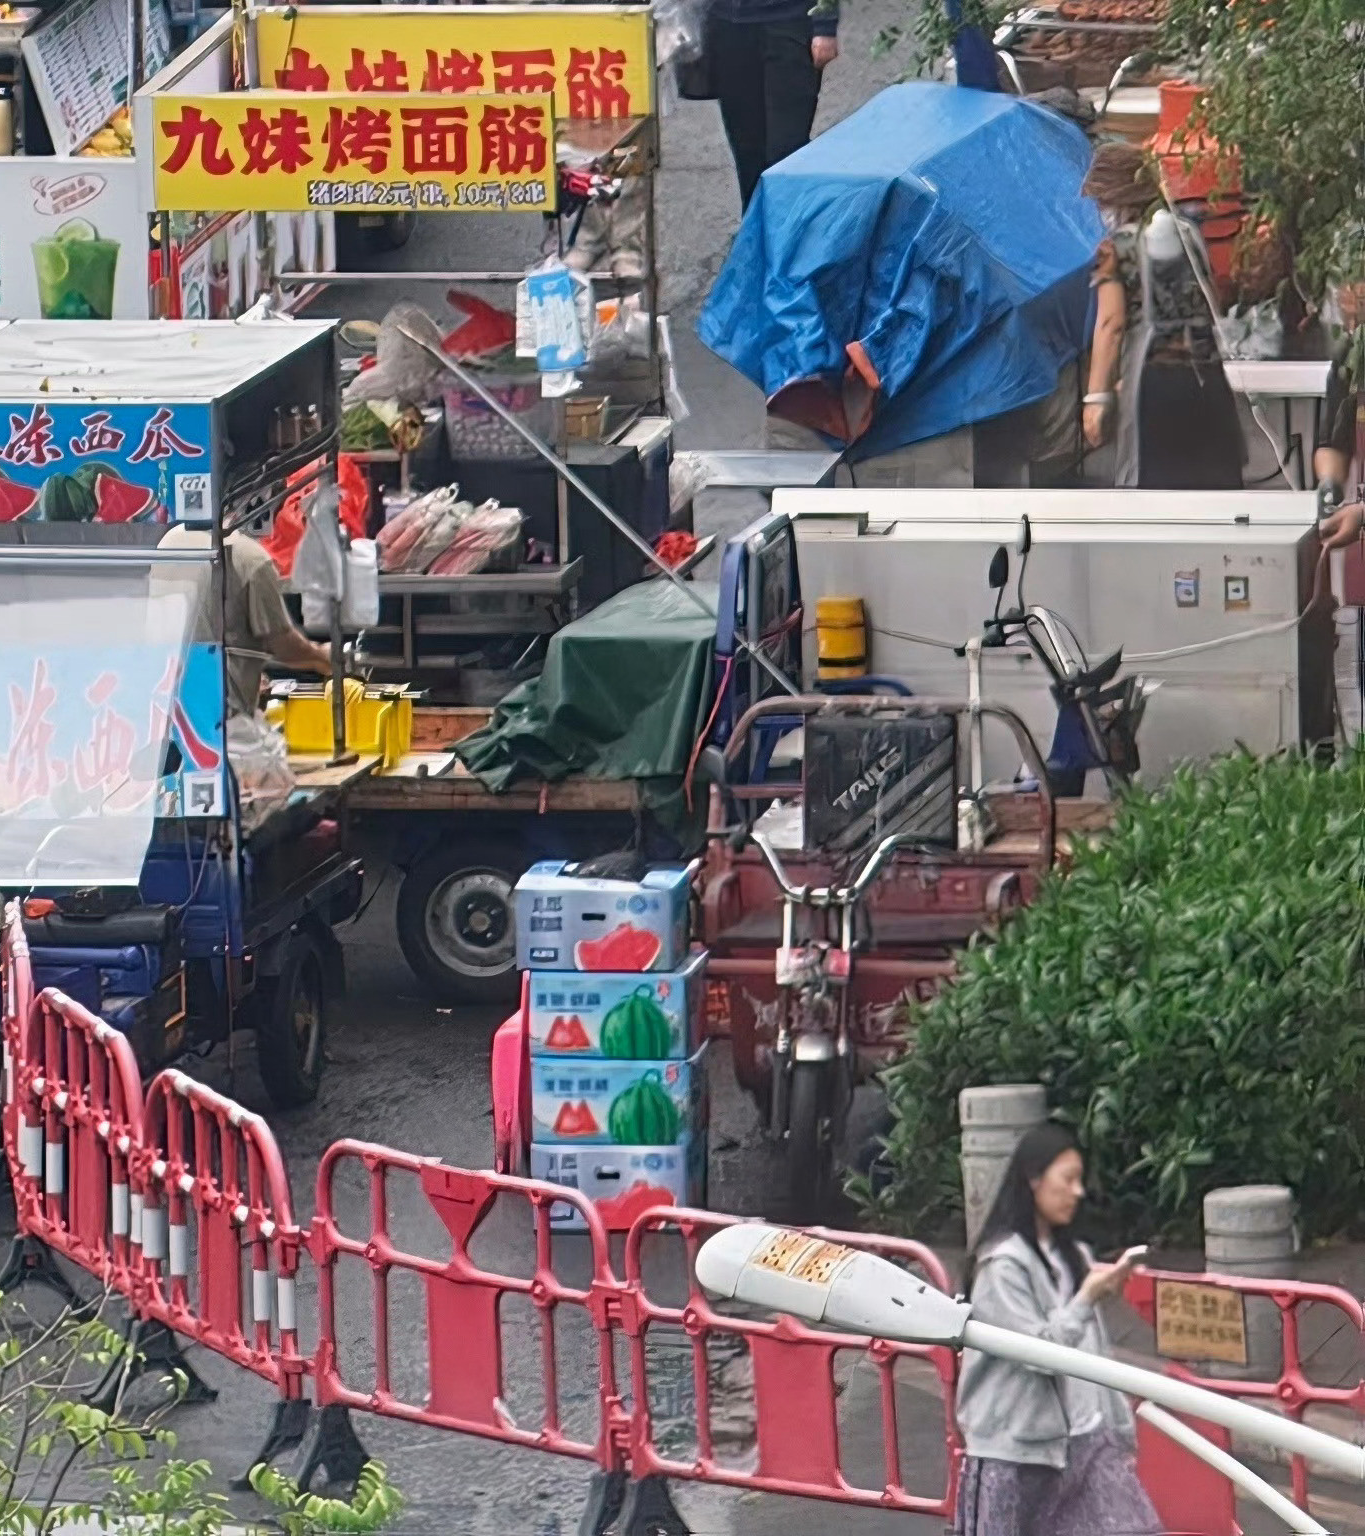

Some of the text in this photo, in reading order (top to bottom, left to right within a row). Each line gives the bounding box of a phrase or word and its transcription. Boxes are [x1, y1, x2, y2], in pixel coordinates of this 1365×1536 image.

[160, 104, 549, 176] 九妹烤面筋
